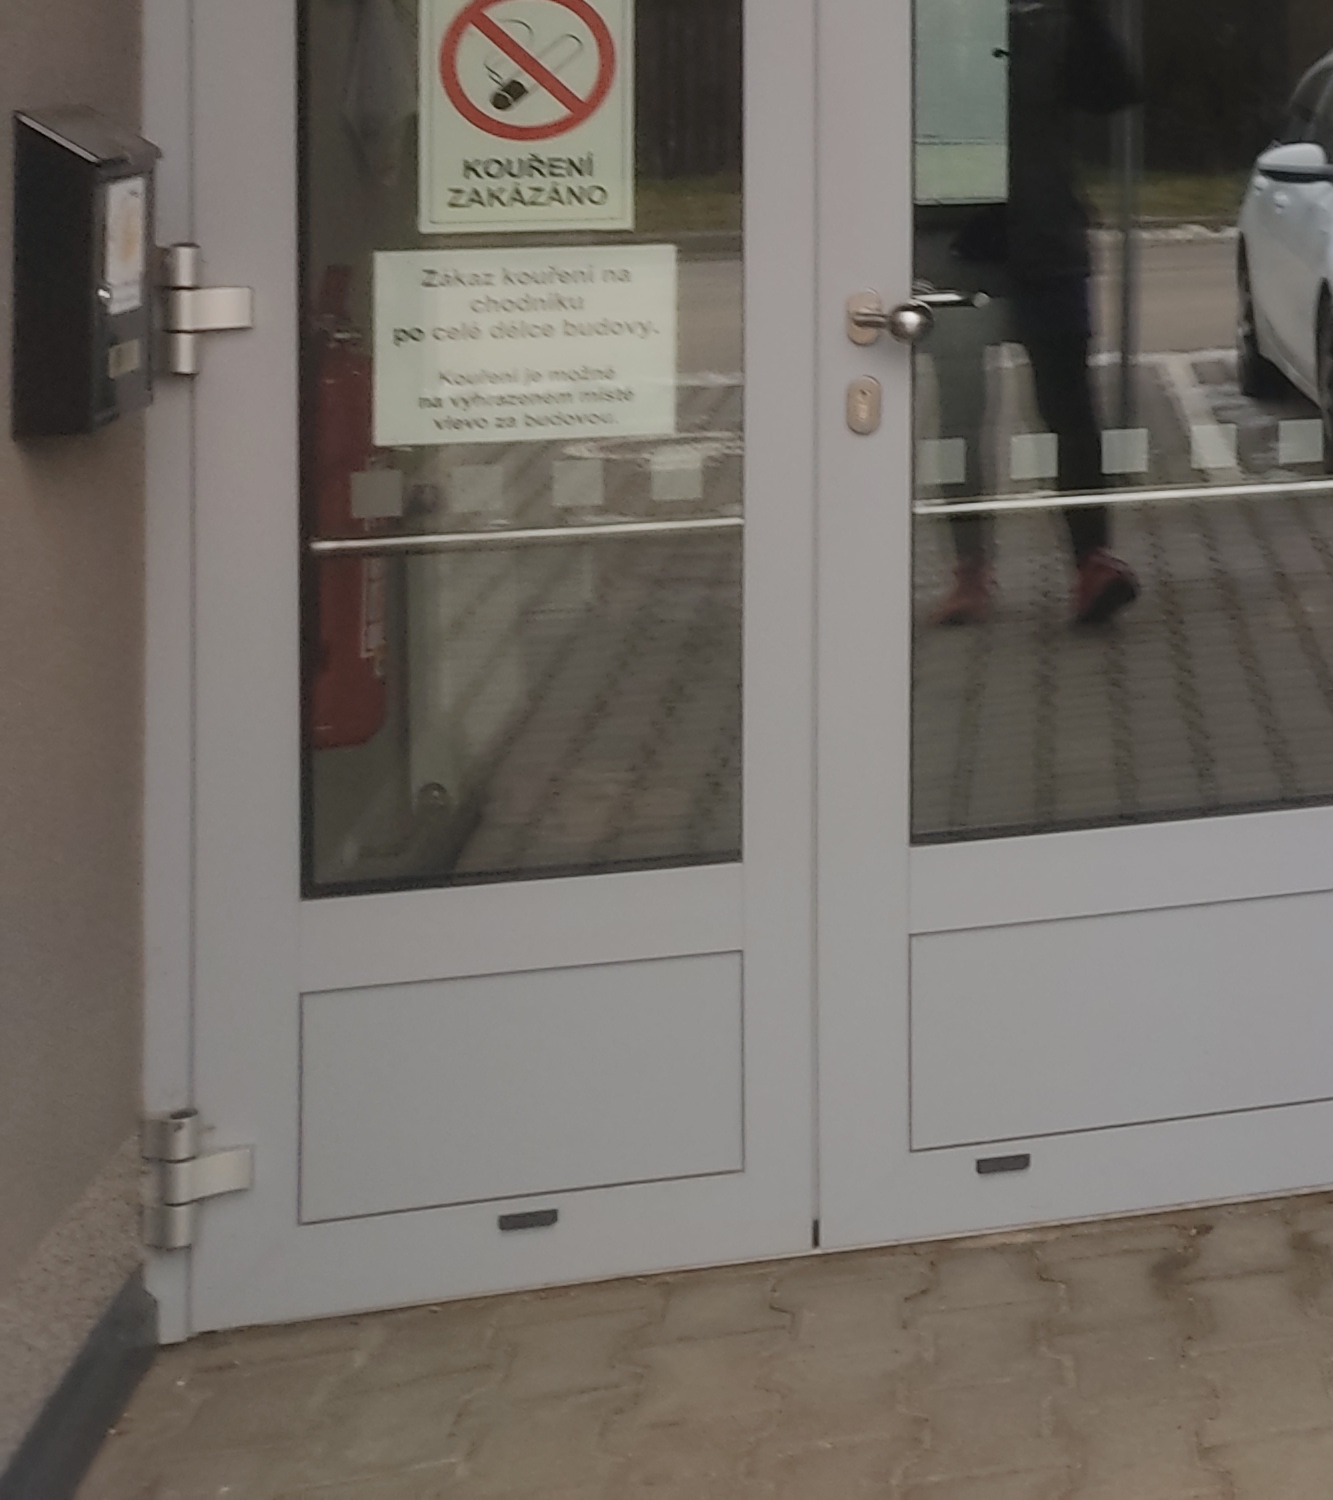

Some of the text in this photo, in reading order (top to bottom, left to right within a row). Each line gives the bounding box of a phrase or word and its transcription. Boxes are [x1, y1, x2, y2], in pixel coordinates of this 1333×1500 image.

[462, 151, 594, 180] KOUŘENÍ
[448, 183, 608, 209] ZAKÁZÁNO
[392, 328, 426, 346] po
